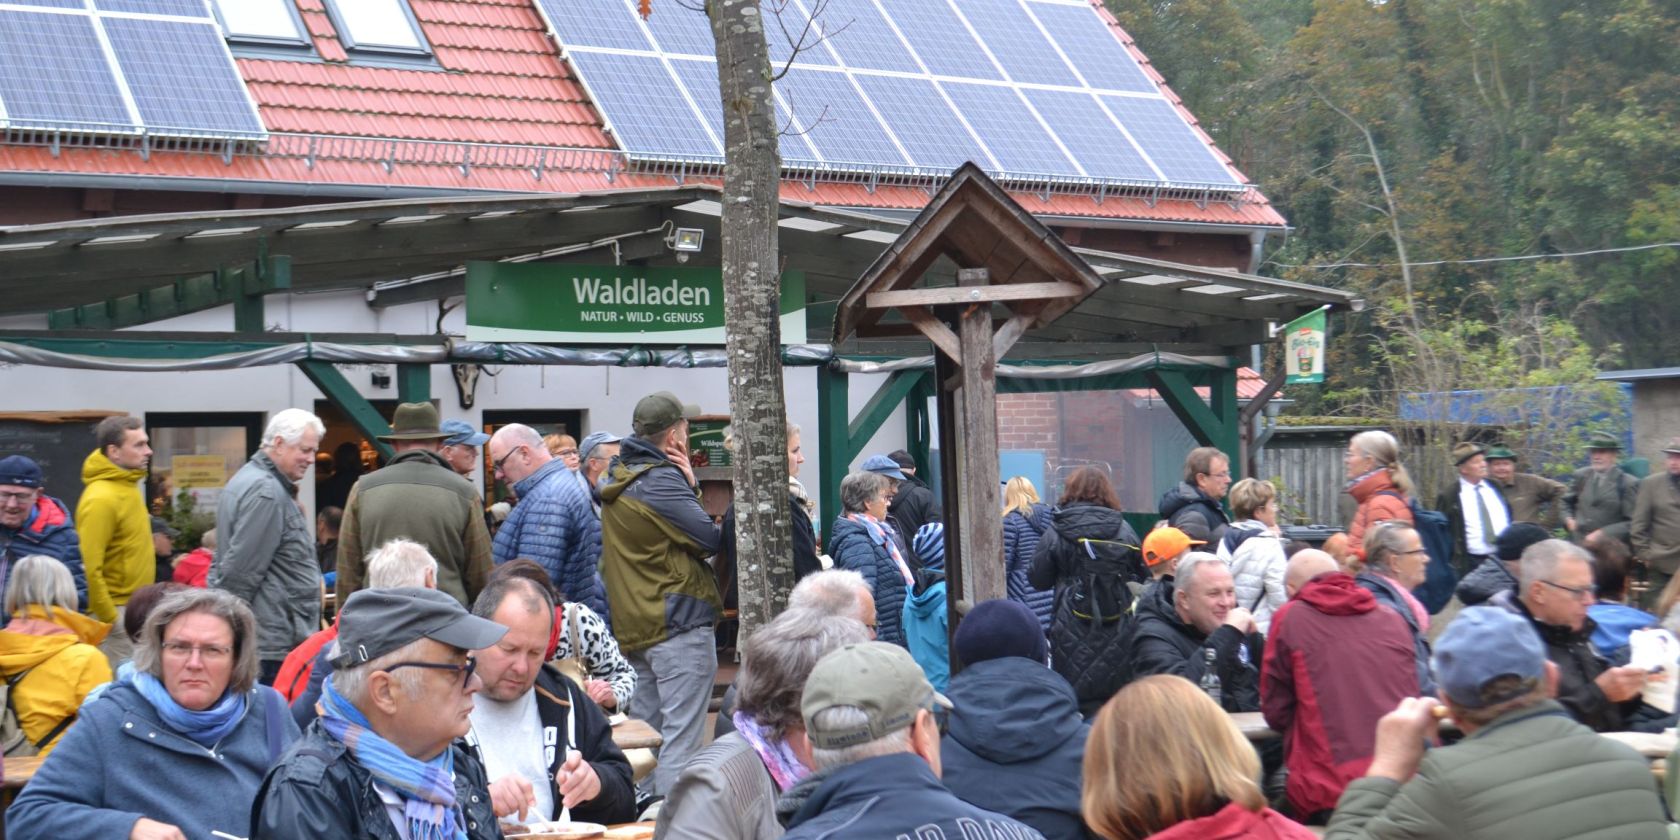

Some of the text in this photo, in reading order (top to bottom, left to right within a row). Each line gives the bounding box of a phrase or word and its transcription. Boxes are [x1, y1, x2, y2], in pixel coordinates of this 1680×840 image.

[572, 277, 711, 306] Waldladen
[580, 311, 705, 323] NATUR WILD GENUSS
